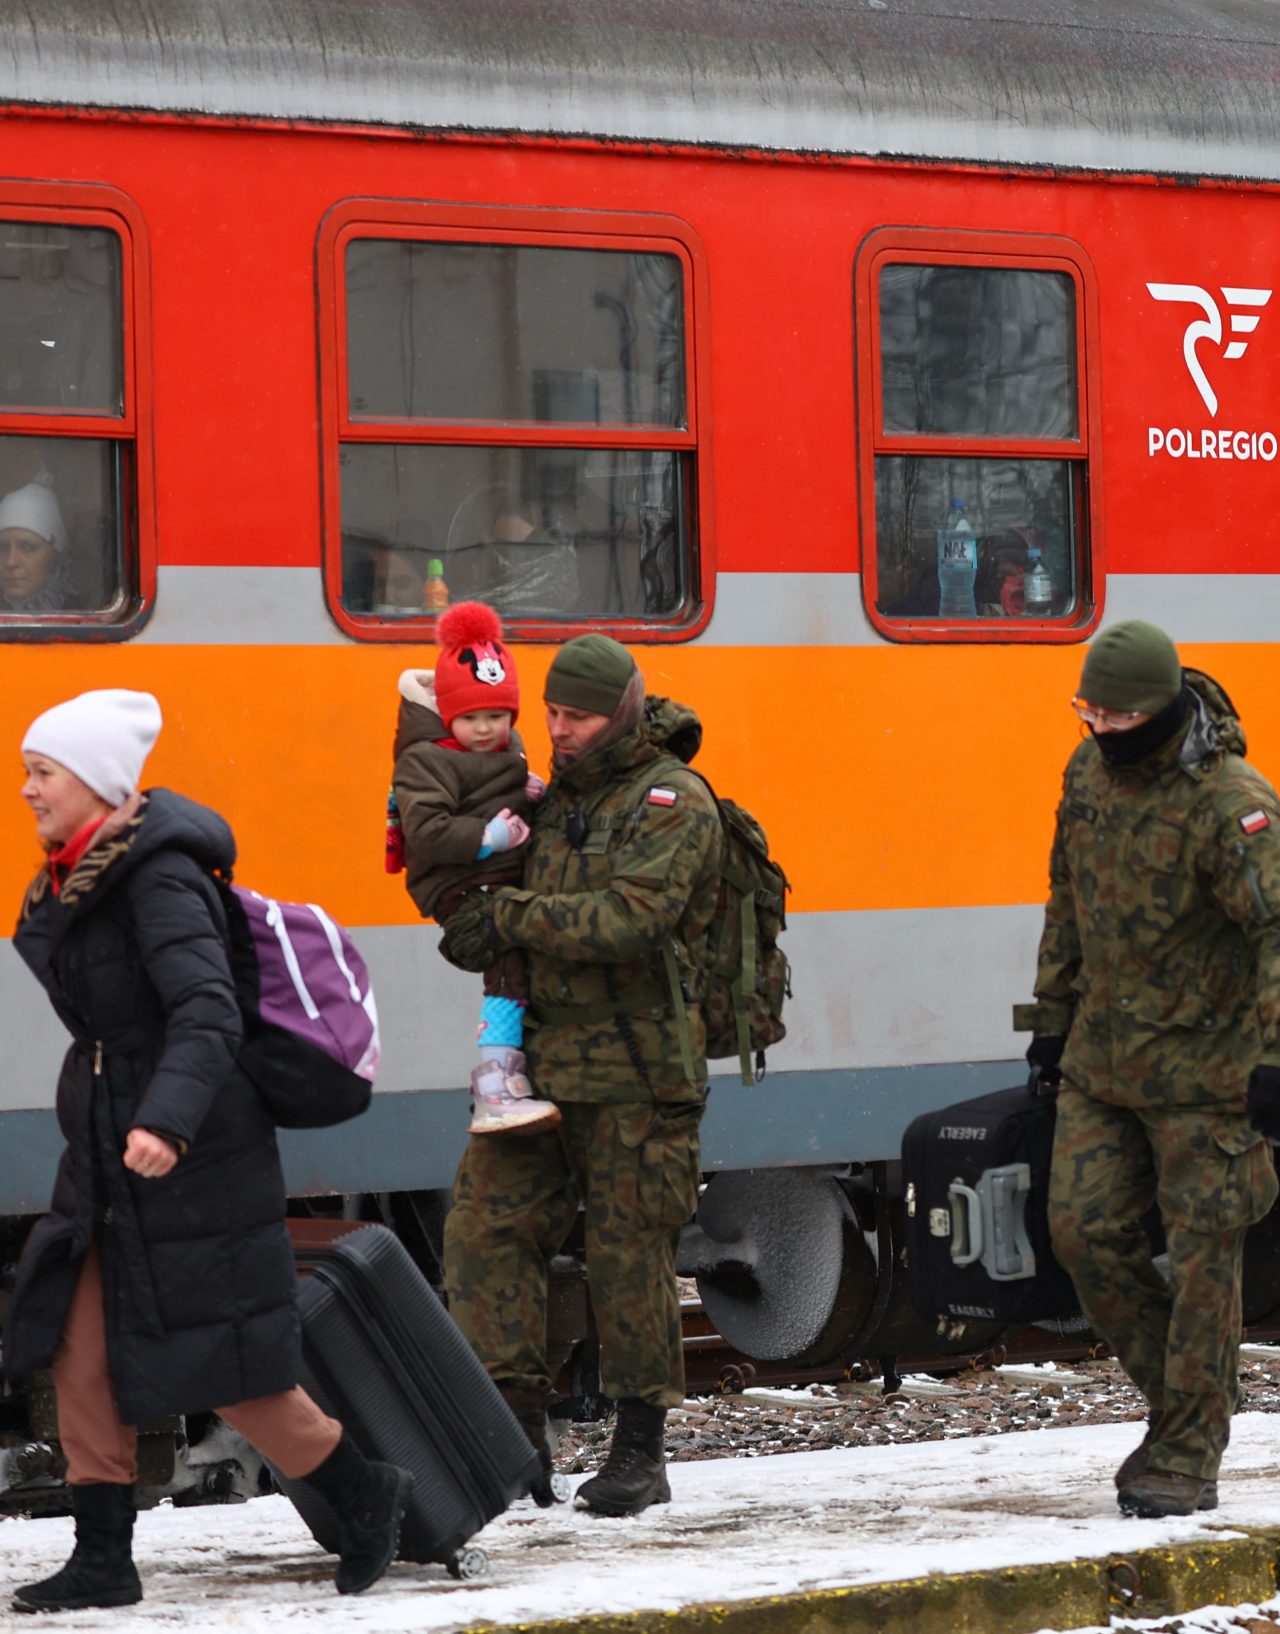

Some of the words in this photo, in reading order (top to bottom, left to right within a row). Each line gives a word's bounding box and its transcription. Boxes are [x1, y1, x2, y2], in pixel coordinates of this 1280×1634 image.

[1148, 427, 1278, 461] POLREGIO
[938, 1125, 987, 1141] EAGERLY
[947, 1303, 995, 1319] EAGERLY
